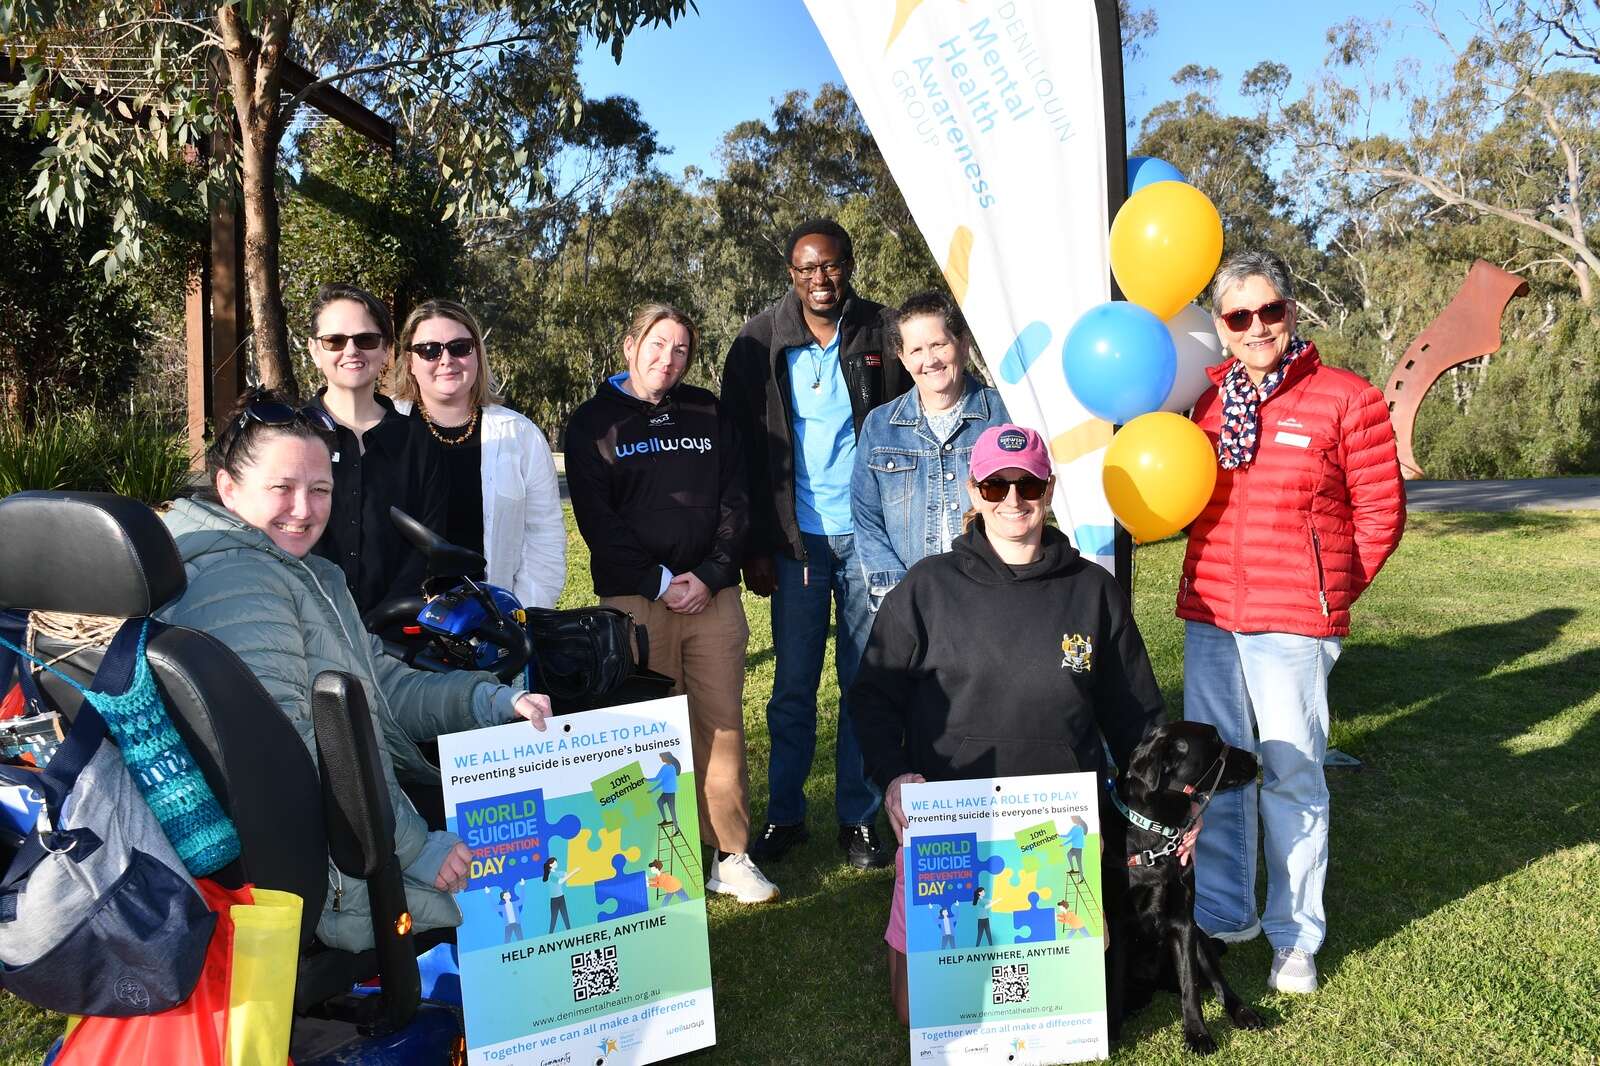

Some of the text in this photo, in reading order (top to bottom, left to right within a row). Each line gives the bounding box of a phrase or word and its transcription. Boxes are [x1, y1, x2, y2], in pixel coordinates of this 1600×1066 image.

[968, 17, 1035, 121] Mental
[997, 1, 1076, 143] DENILIQUIN
[939, 35, 999, 134] Health
[892, 70, 940, 147] GROUP
[912, 56, 996, 209] Awareness
[615, 437, 712, 458] wellways
[454, 721, 668, 769] WE ALL HAVE A ROLE TO PLAY
[450, 736, 681, 786] Preventing suicide is everyone's business
[599, 777, 646, 807] September
[609, 772, 631, 790] 10th
[465, 799, 537, 827] WORLD
[908, 804, 1088, 823] Preventing suicide is everyone's business
[911, 791, 1079, 811] WE ALL HAVE A ROLE TO PLAY
[467, 818, 538, 847] SUICIDE
[1020, 833, 1059, 853] September
[1030, 829, 1047, 841] 10th
[916, 840, 971, 857] WORLD
[470, 855, 506, 880] DAY
[918, 855, 972, 872] SUICIDE
[918, 869, 973, 881] PREVENTION
[918, 881, 946, 897] DAY
[501, 915, 667, 964] HELP ANYWHERE, ANYTIME
[938, 946, 1070, 965] HELP ANYWHERE, ANYTIME
[532, 987, 661, 1028] www.denimentalhealth.org.au
[482, 998, 697, 1062] Together we can all make a difference
[921, 1017, 1093, 1041] Together we can all make a difference
